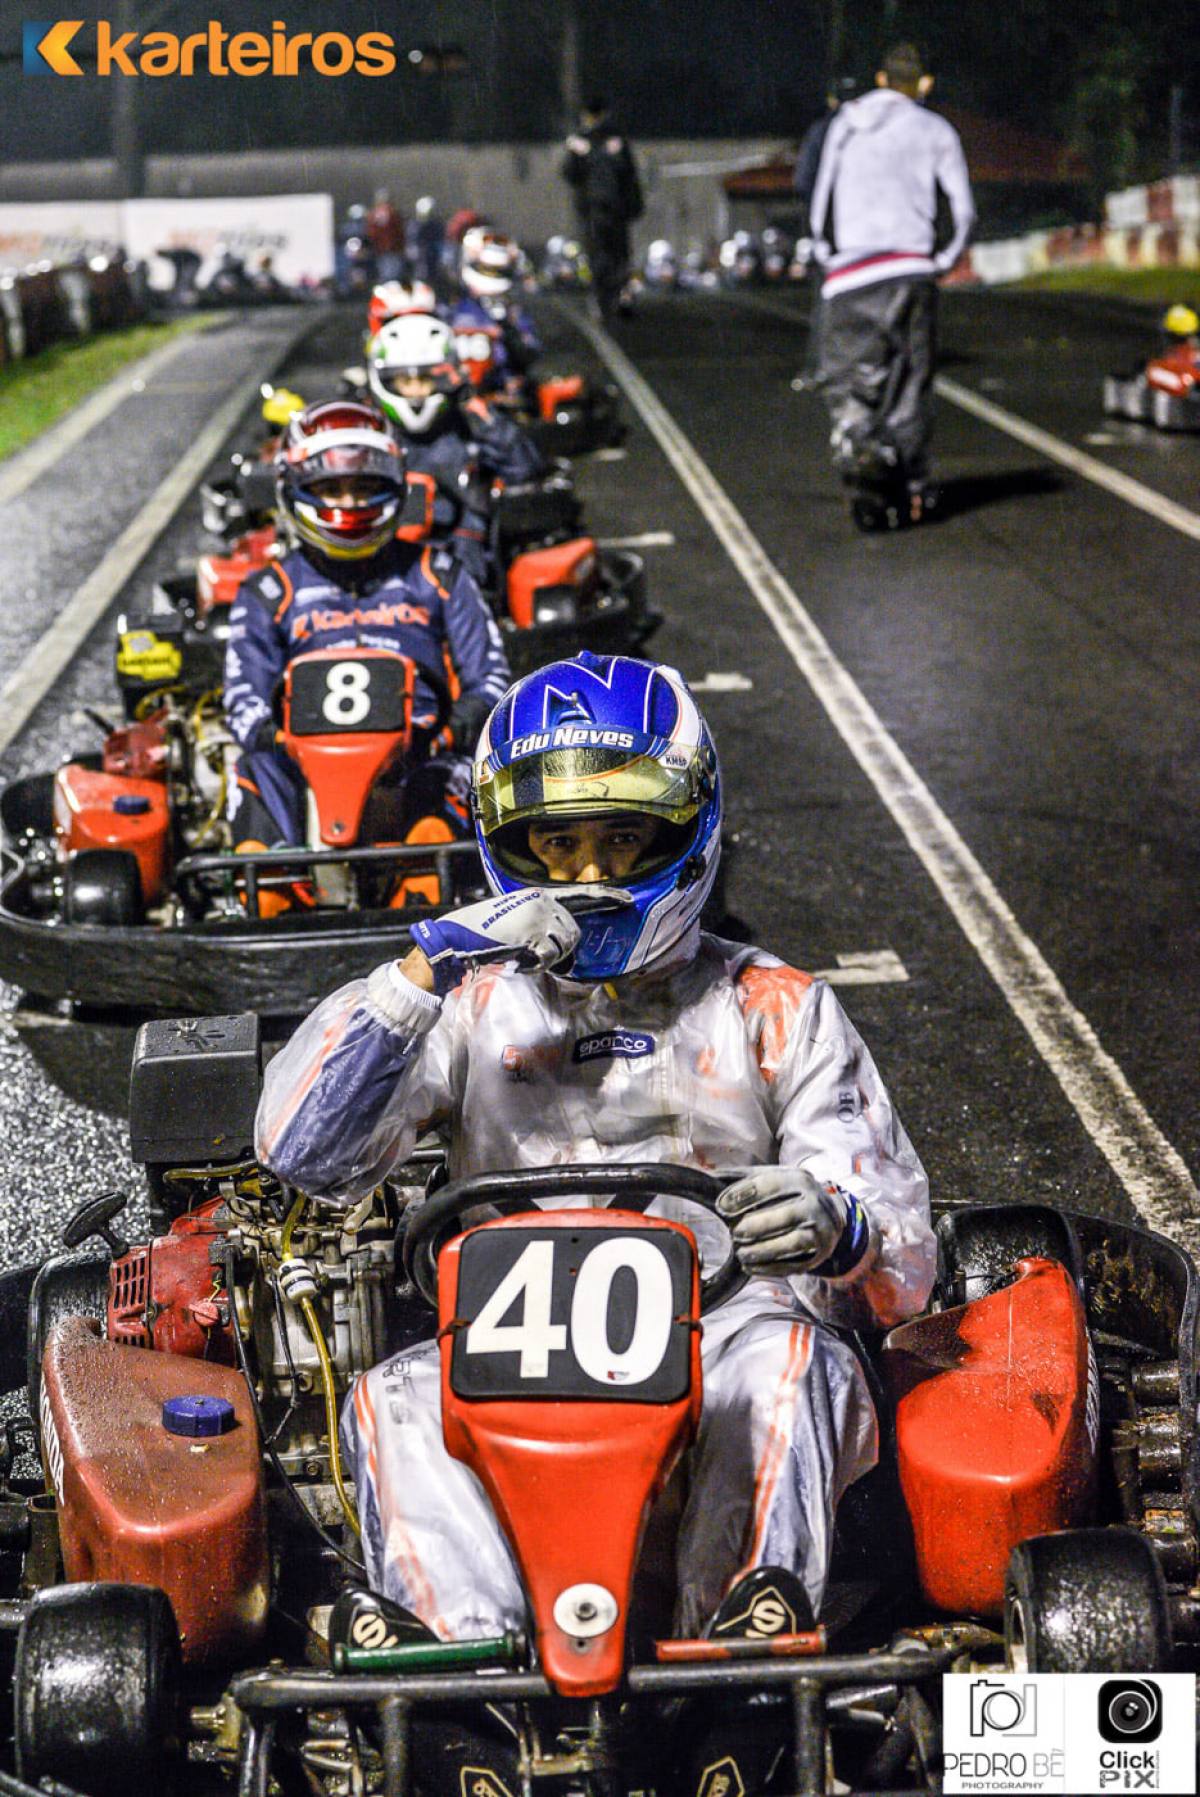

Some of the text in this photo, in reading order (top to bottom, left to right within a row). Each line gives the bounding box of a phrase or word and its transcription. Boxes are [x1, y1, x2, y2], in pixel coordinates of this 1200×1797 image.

[322, 661, 371, 725] 8
[510, 727, 634, 760] Edu Neves
[481, 891, 540, 930] BRASILEIRO
[466, 1236, 673, 1385] 40
